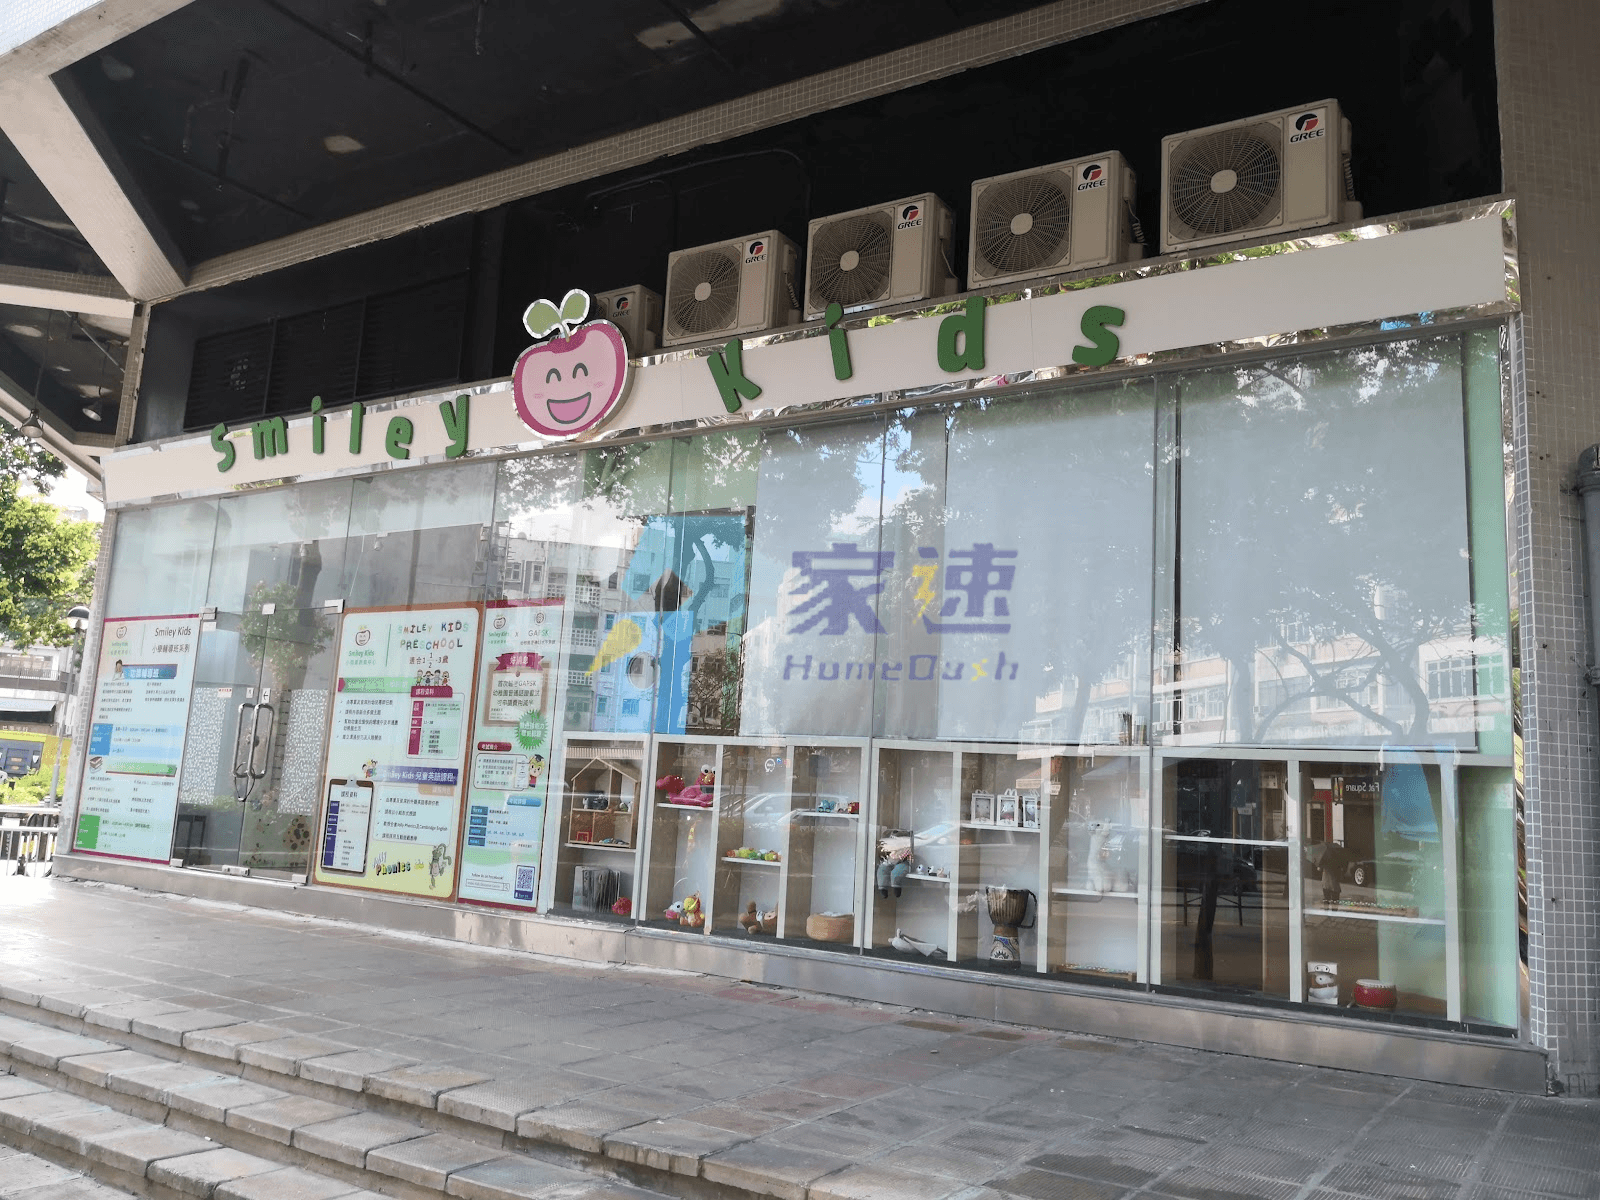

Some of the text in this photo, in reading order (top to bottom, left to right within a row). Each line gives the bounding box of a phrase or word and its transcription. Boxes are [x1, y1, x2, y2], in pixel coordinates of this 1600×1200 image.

[1290, 128, 1324, 143] GREE
[1077, 179, 1107, 191] GREE
[898, 218, 922, 230] GREE
[745, 253, 767, 264] GREE
[707, 295, 1125, 413] Kids
[154, 625, 191, 638] Smiley Kids
[398, 621, 469, 634] SMILEY KIDS
[400, 638, 463, 651] PRESCHOOL
[375, 861, 411, 876] Phonics
